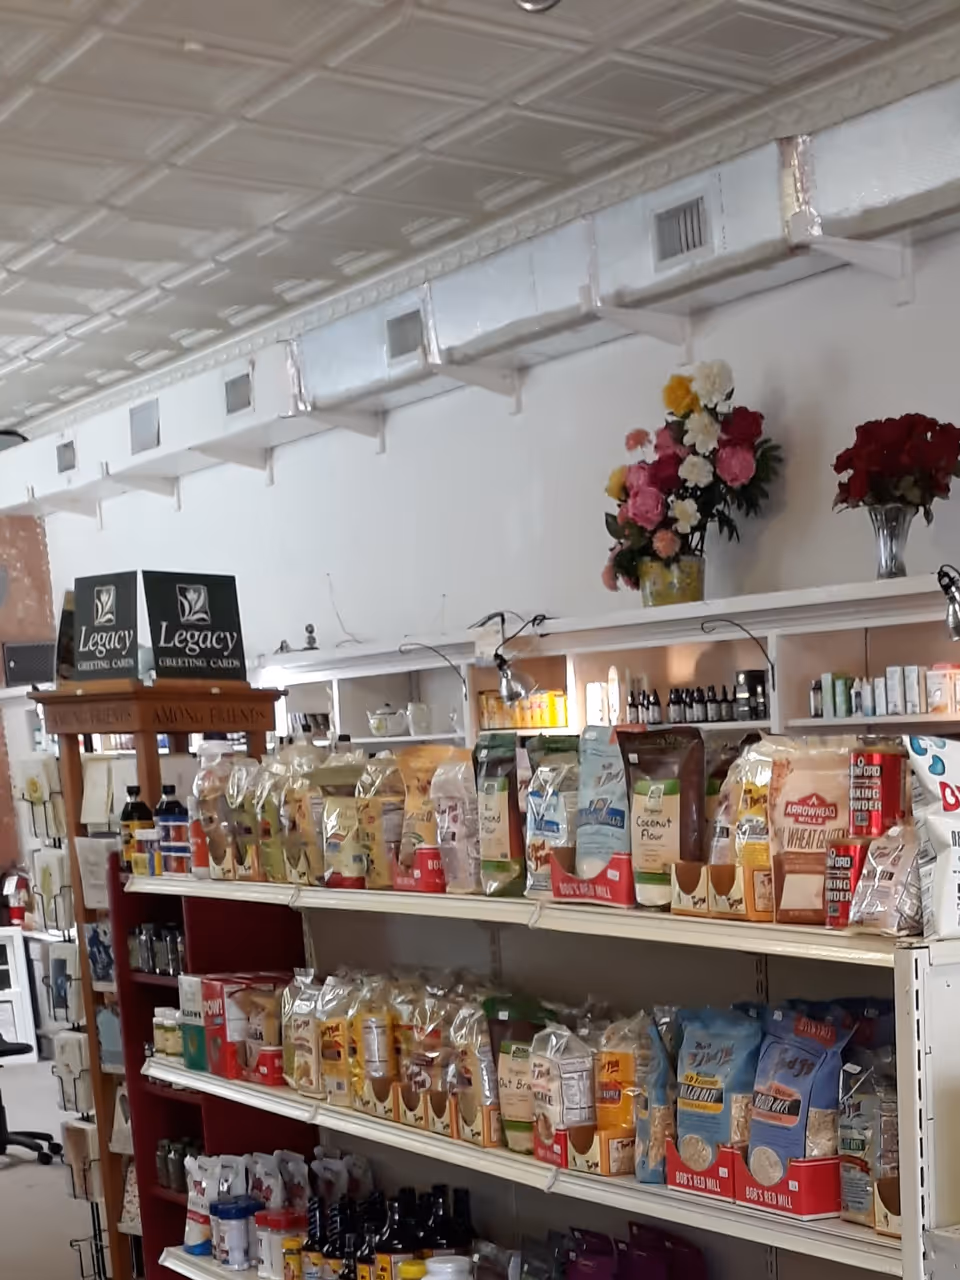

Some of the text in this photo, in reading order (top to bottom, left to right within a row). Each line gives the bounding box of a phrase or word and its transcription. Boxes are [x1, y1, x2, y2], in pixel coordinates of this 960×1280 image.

[78, 626, 134, 657] Legacy
[159, 621, 237, 656] Legacy
[112, 659, 134, 669] CARDS
[159, 658, 240, 668] GREETING CARDS
[153, 706, 203, 724] AMONG
[786, 804, 836, 817] ARROWHEAD
[636, 815, 673, 829] Coconut
[640, 830, 664, 841] Flour
[676, 1171, 720, 1192] BOB'S RED MILL
[745, 1186, 793, 1209] BOB'S RED MILL
